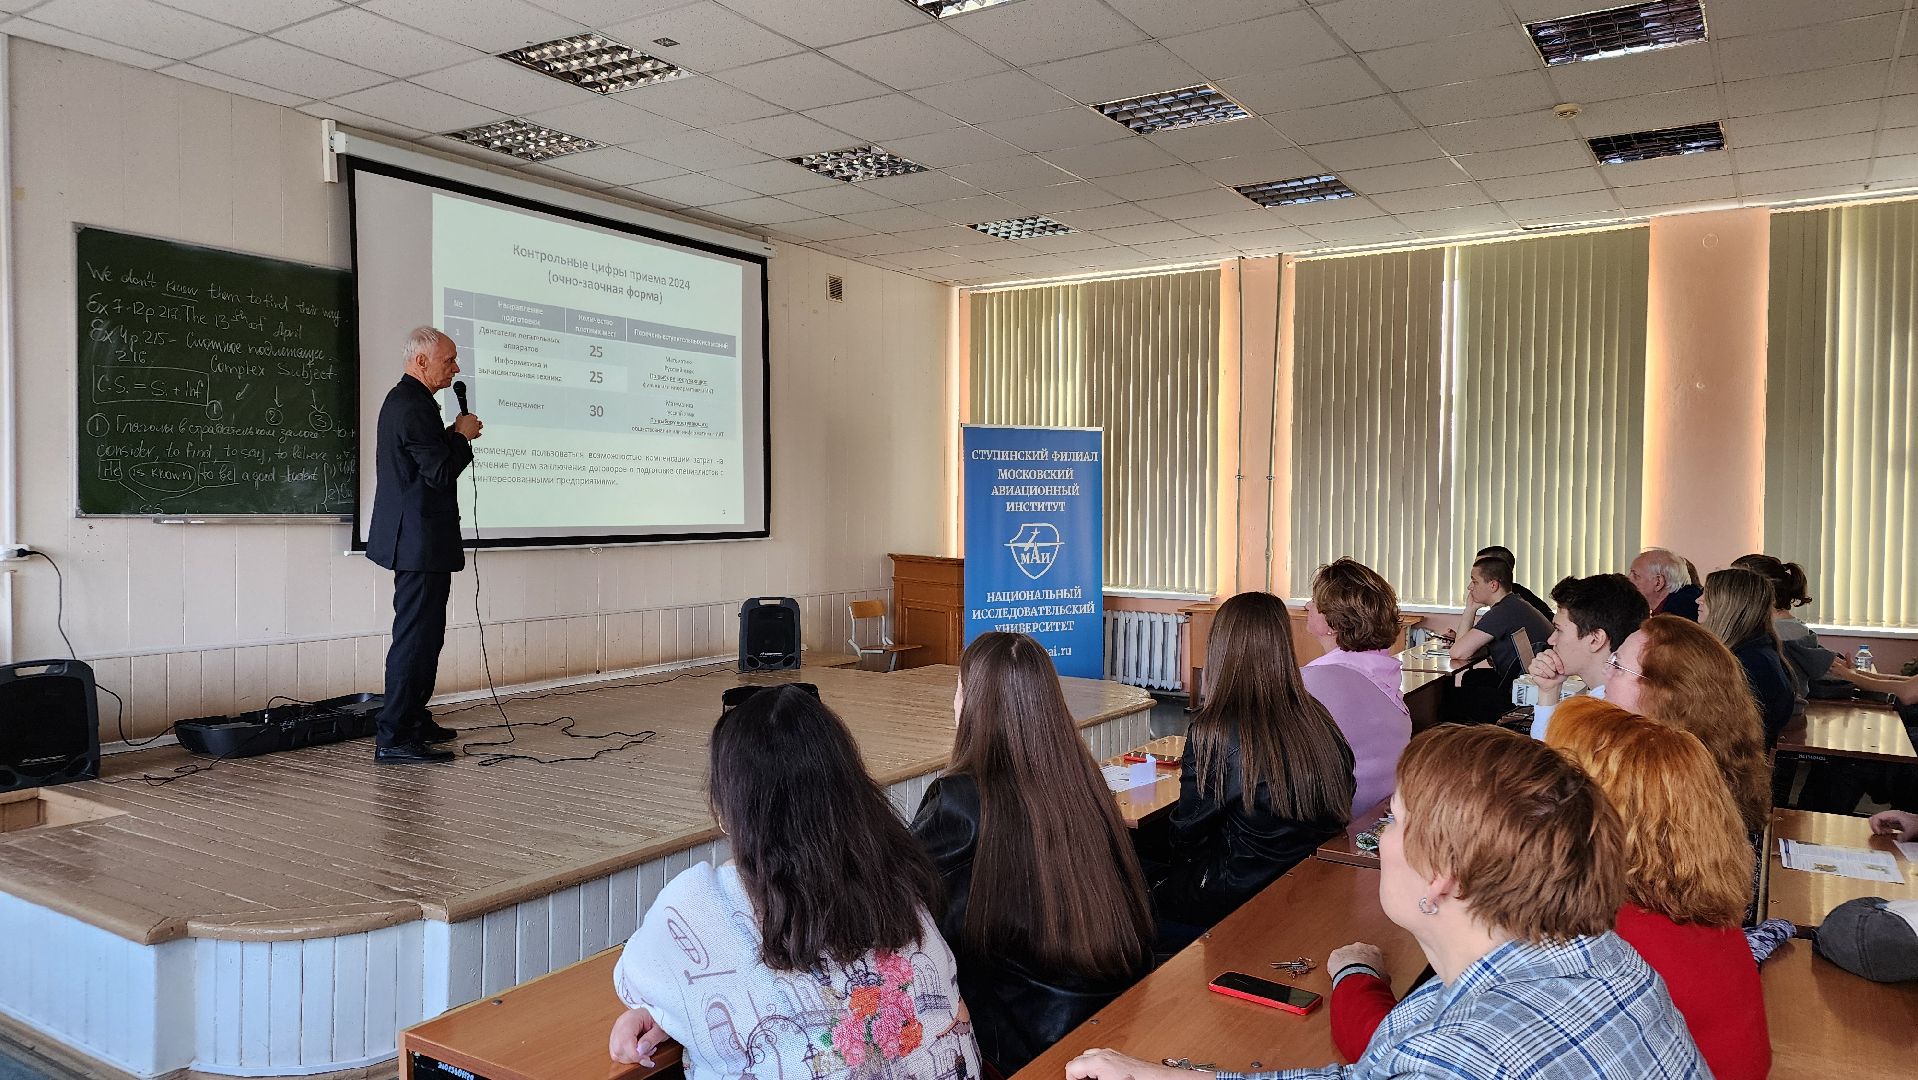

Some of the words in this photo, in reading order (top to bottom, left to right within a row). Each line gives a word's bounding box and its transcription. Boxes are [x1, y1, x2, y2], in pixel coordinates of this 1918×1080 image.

[513, 244, 588, 269] Контрольные
[591, 262, 627, 278] цифры
[630, 271, 671, 285] приема
[669, 277, 690, 290] 2024
[86, 261, 113, 282] We
[120, 268, 157, 288] don't
[166, 280, 199, 296] know
[548, 269, 624, 295] (очно-заочная
[626, 285, 663, 304] форма)
[180, 304, 208, 325] The
[272, 321, 303, 341] April
[479, 326, 517, 339] Двигатели
[503, 343, 539, 353] аппаратов
[589, 345, 603, 358] 25
[210, 354, 266, 380] Complex
[494, 355, 542, 370] Информатика
[589, 370, 603, 384] 25
[185, 379, 205, 399] Inf
[498, 398, 545, 411] Менеджмент
[589, 404, 604, 417] 30
[165, 442, 181, 458] to
[223, 444, 238, 458] to
[273, 447, 289, 460] to
[473, 446, 527, 457] екомендуем
[971, 448, 1049, 461] СТУПИНСКИЙ
[1051, 450, 1099, 462] ФИЛИАЛ
[104, 461, 121, 477] He
[151, 467, 192, 481] known
[200, 467, 214, 480] to
[219, 463, 233, 481] be
[241, 471, 250, 481] a
[997, 467, 1074, 480] МОСКОВСКИЙ
[990, 483, 1080, 497] АВИАЦИОННЫЙ
[1005, 501, 1066, 512] ИНСТИТУТ
[1020, 543, 1051, 565] МАИ
[986, 586, 1082, 603] НАЦИОНАЛЬНЫЙ
[971, 601, 1096, 620] ИССЛЕДОВАТЕЛЬСКИЙ
[994, 620, 1075, 634] УНИВЕРСИТЕТ
[1046, 645, 1072, 657] ai.ru
